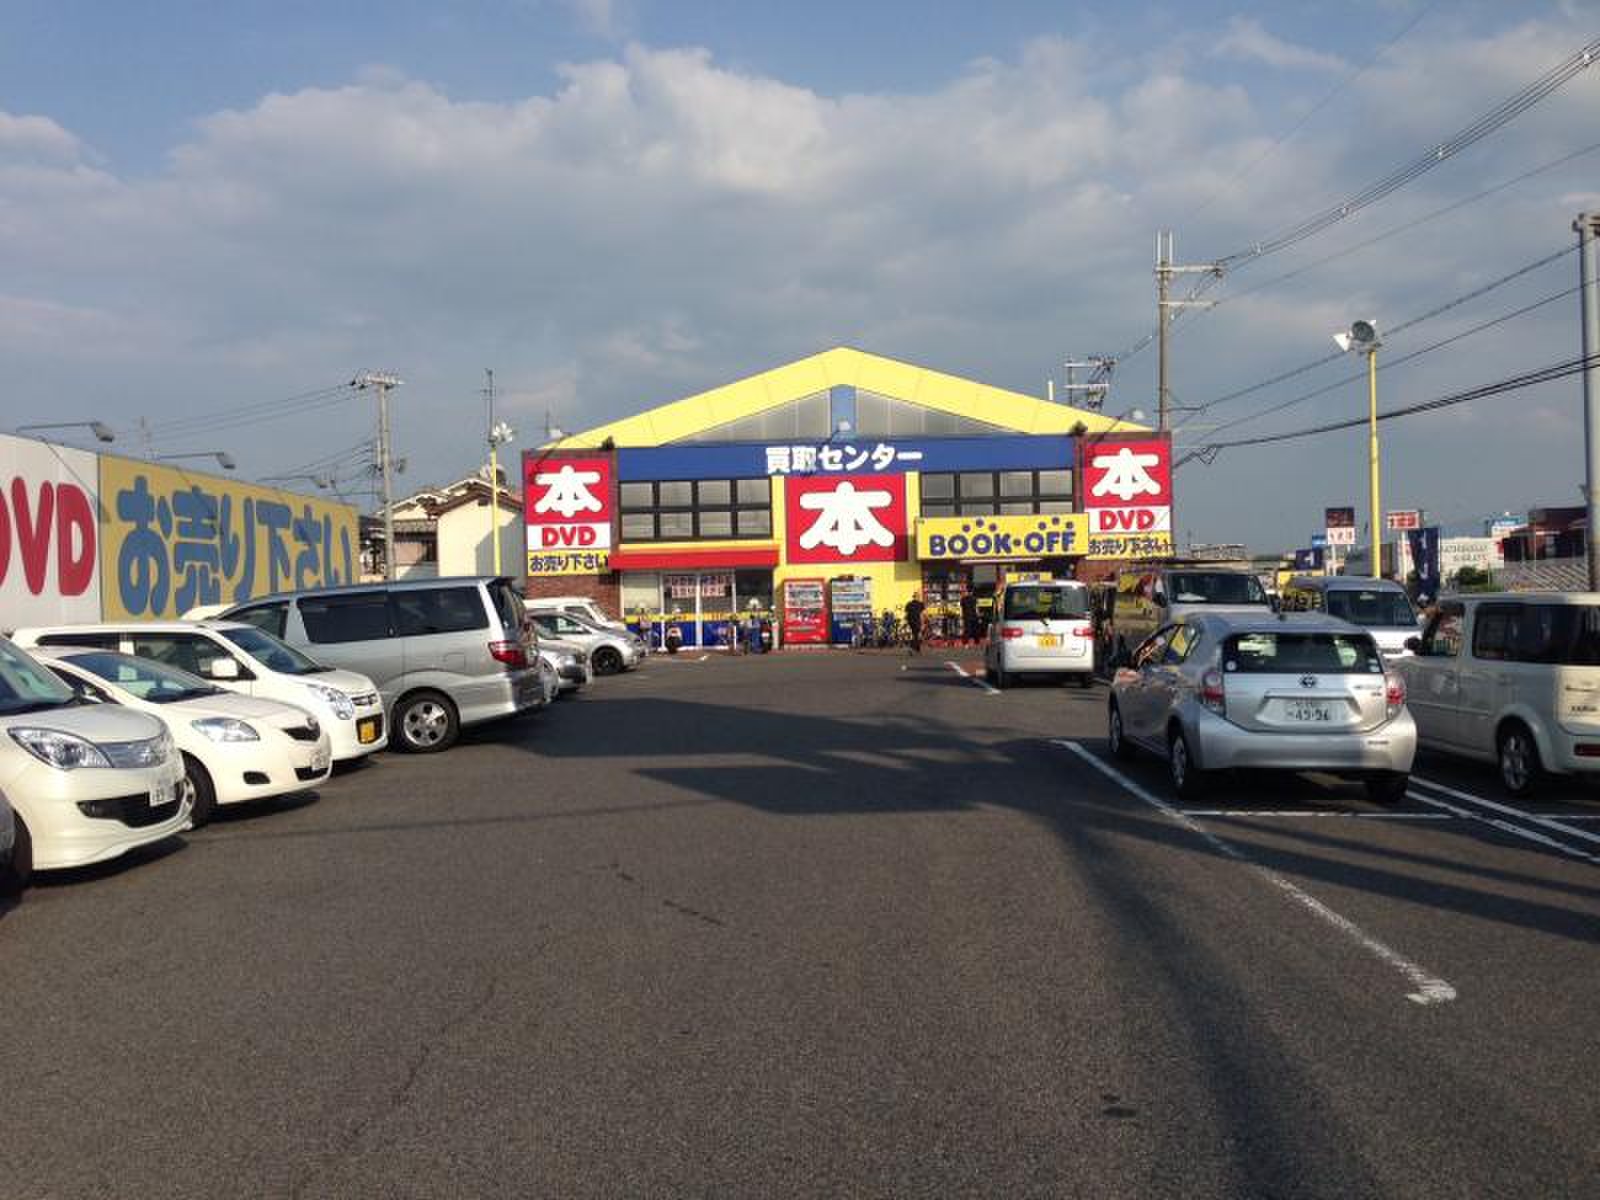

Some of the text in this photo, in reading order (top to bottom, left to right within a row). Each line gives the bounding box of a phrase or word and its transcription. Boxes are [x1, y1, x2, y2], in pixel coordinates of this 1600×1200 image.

[766, 443, 923, 474] 買取センター
[1091, 448, 1161, 500] 本
[534, 465, 602, 518] 本
[0, 476, 96, 596] VD
[542, 526, 597, 546] DVD
[799, 481, 895, 556] 本
[1099, 509, 1154, 531] DVD
[117, 475, 352, 617] お売り下さい
[529, 552, 609, 572] お売り下さい
